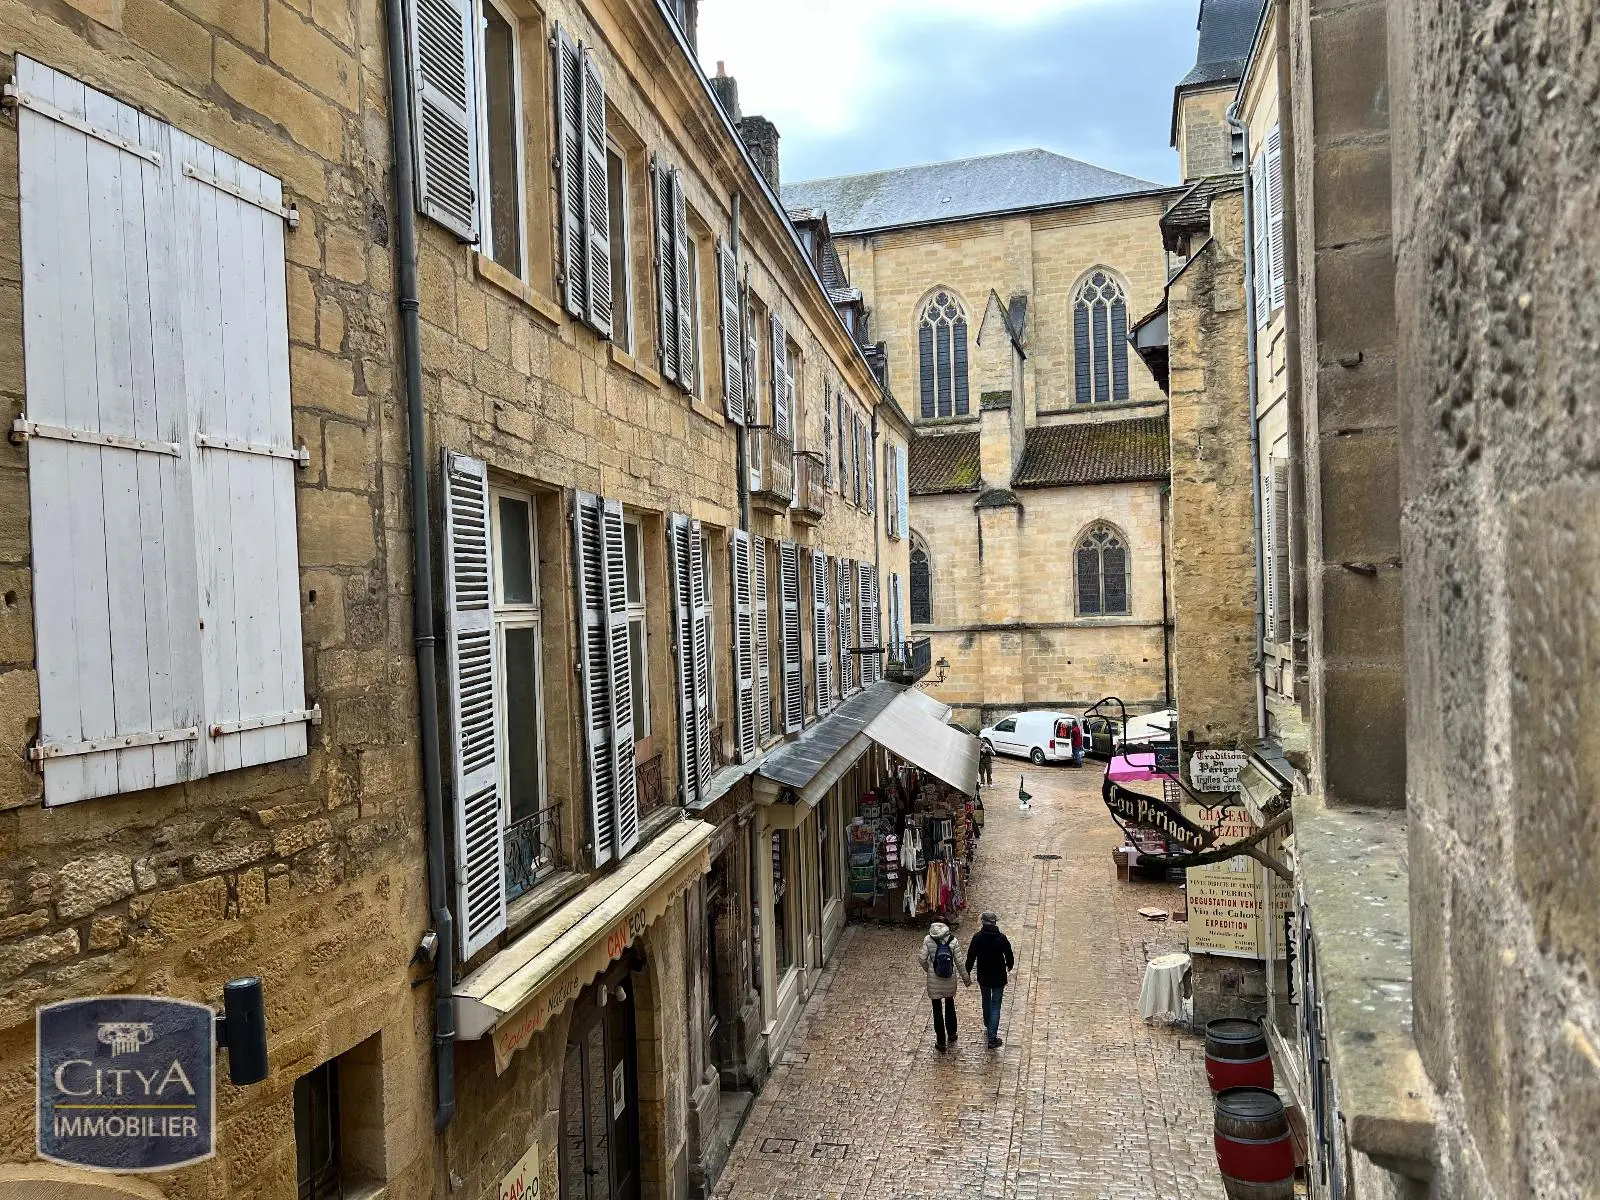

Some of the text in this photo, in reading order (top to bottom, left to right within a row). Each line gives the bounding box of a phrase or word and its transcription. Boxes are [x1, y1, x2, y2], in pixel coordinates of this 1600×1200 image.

[1196, 750, 1247, 760] Traditions
[1107, 784, 1203, 847] Lou Périgord
[1221, 889, 1254, 898] PERRIN
[1189, 896, 1263, 910] DEGUSTATION VENTE
[1193, 907, 1209, 916] Vin
[1212, 908, 1224, 917] de
[1228, 909, 1260, 919] Cahors
[1205, 920, 1248, 930] EXPEDITION
